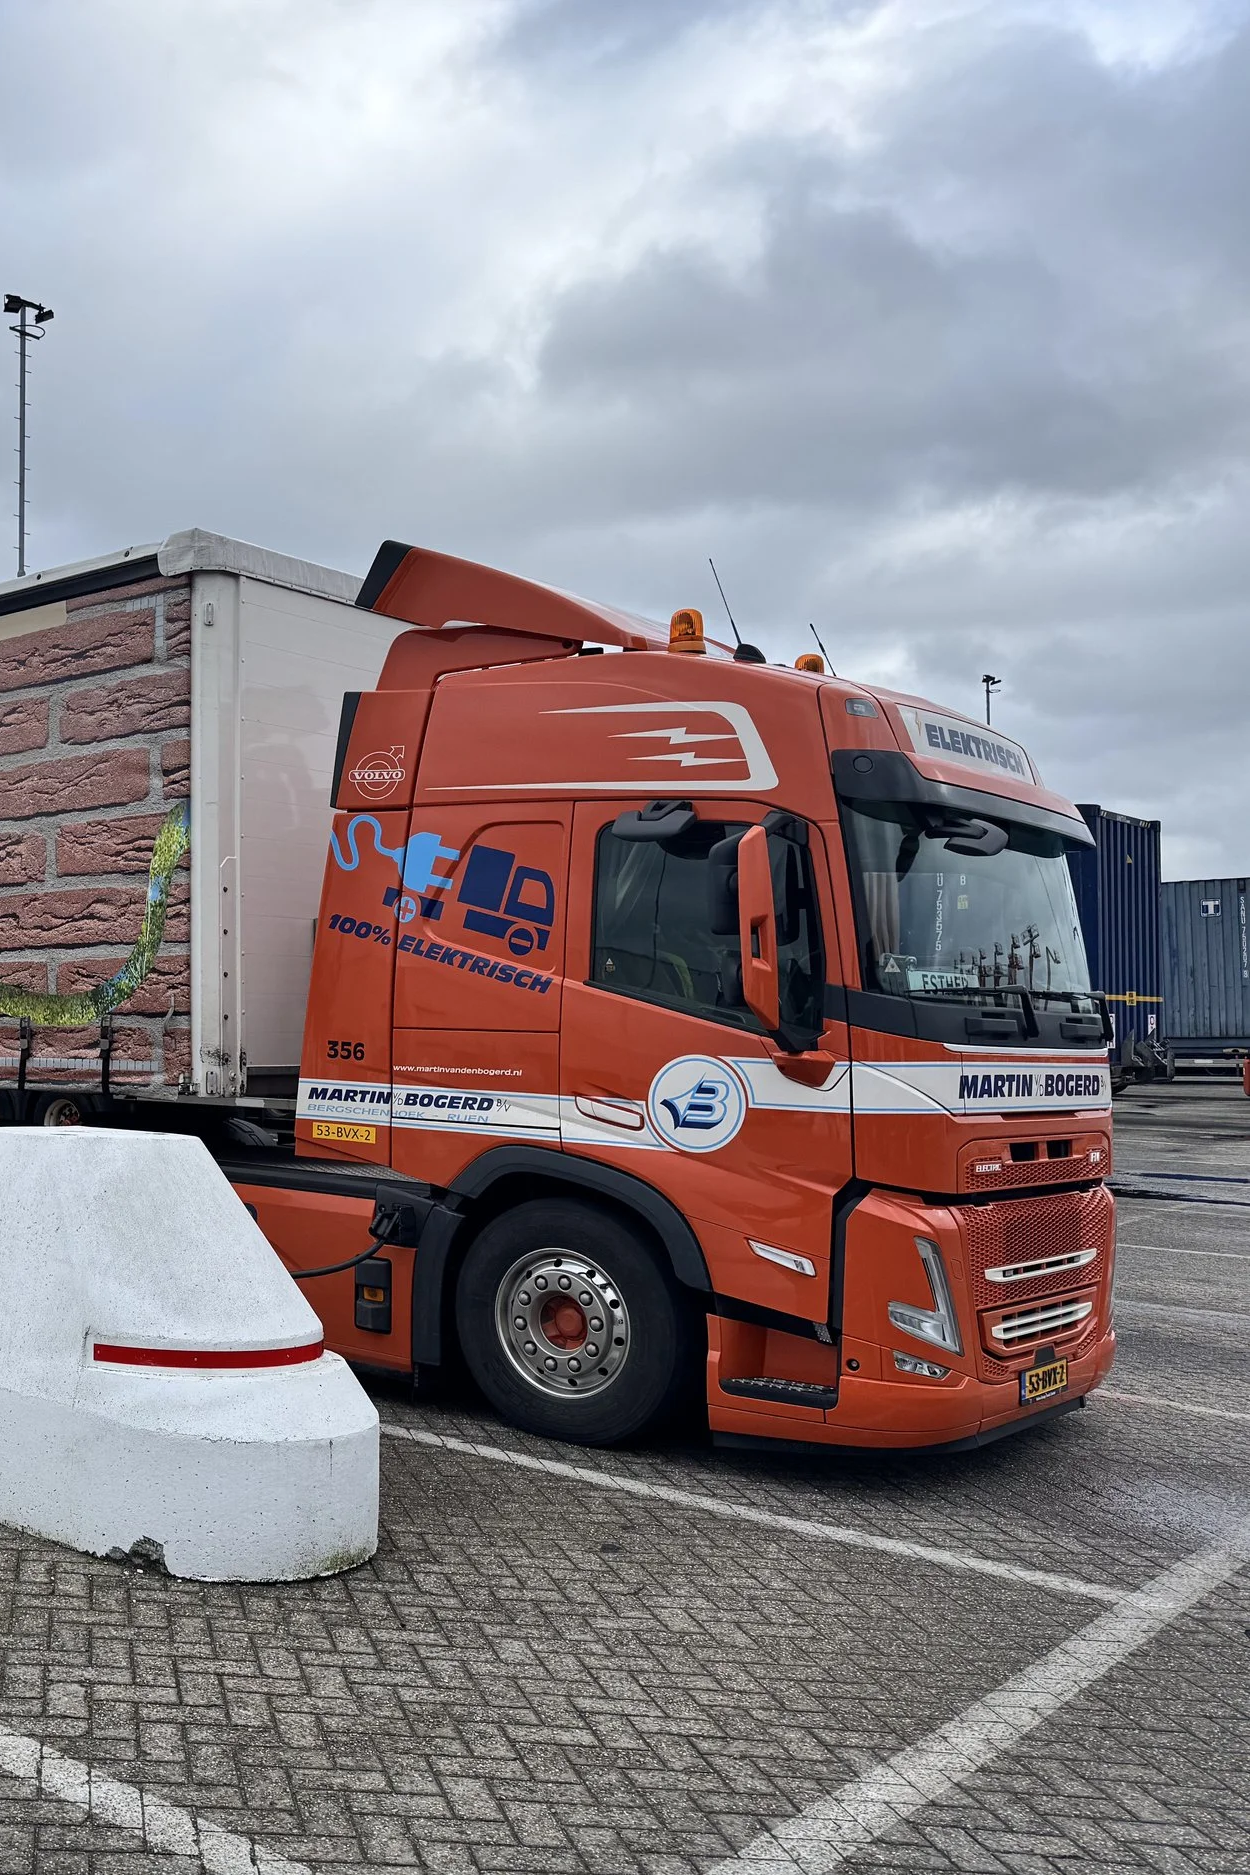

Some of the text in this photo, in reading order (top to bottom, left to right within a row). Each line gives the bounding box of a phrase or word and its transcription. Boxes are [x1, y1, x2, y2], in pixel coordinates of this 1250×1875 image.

[925, 723, 1025, 776] ELEKTRISCH
[353, 771, 402, 780] VOLVO
[328, 913, 554, 994] 100% ELEKTRISCH
[326, 1040, 365, 1061] 356
[393, 1064, 522, 1076] www.martinvandenbogerd.nl
[958, 1074, 1033, 1099] MARTIN
[1044, 1074, 1100, 1096] BOGERD
[307, 1103, 426, 1119] BERGSCHENHOEK
[308, 1087, 391, 1105] MARTIN
[403, 1093, 494, 1112] BOGERD
[316, 1125, 371, 1141] 53-BVX-2
[1029, 1364, 1065, 1393] 53-BVX-2
